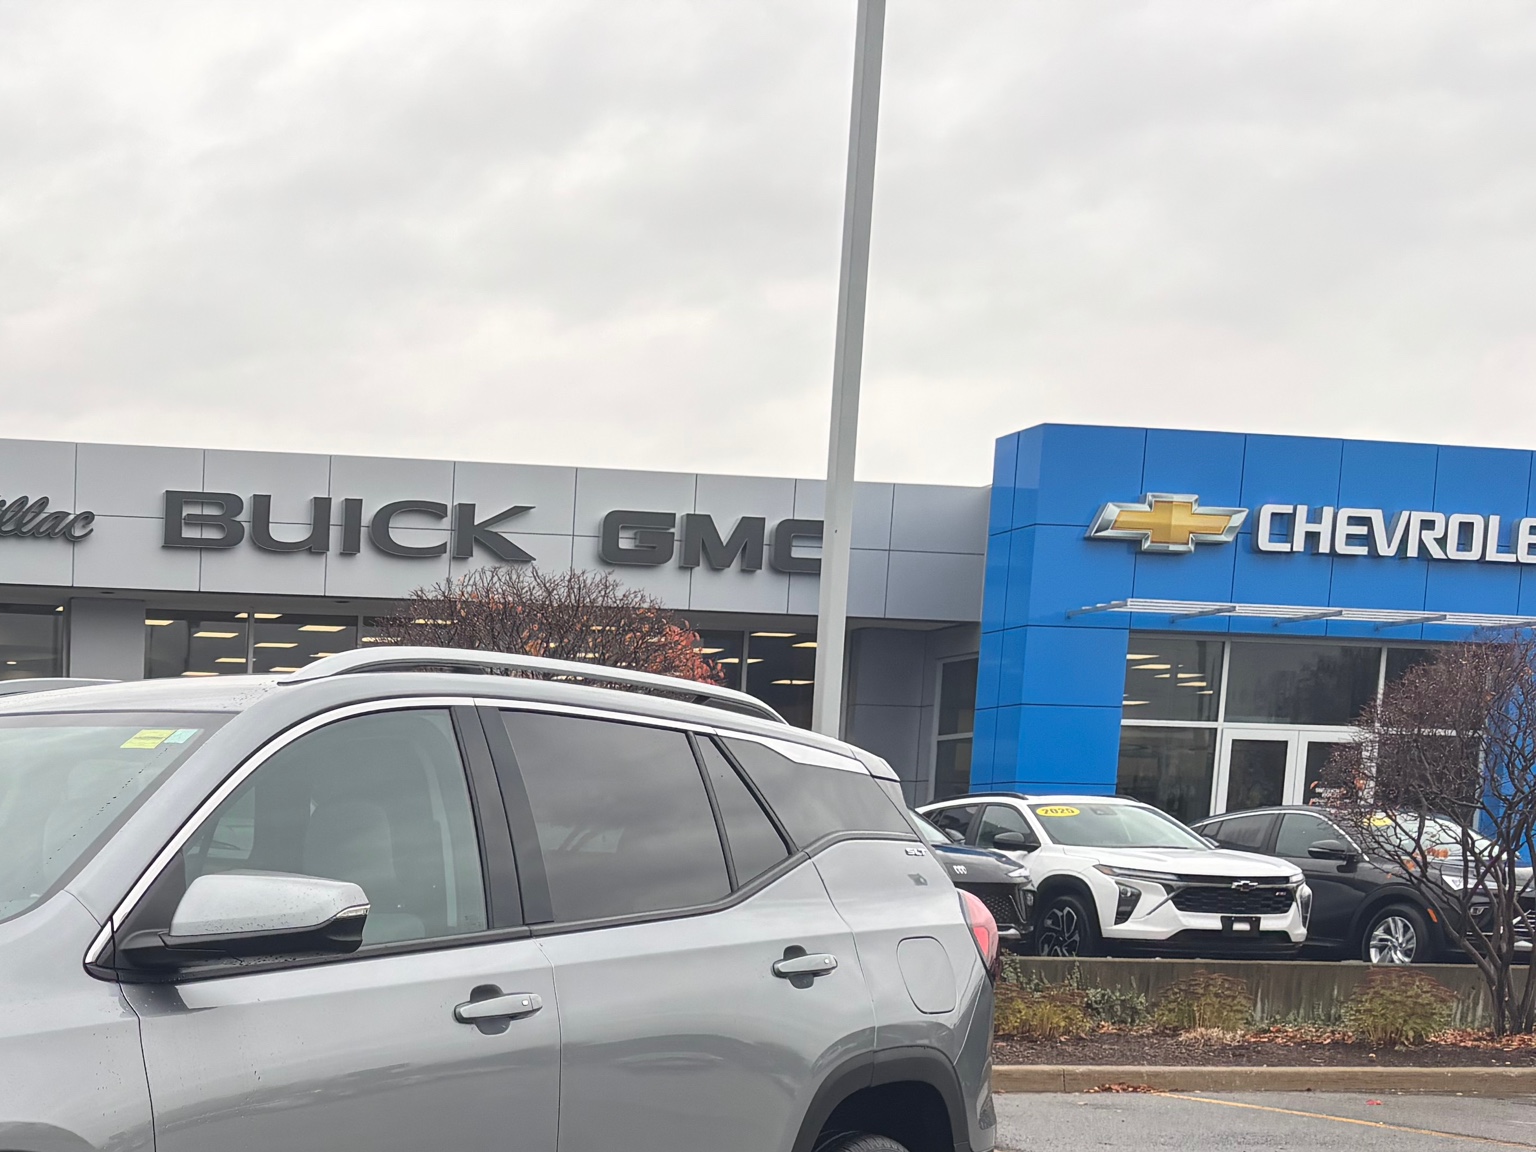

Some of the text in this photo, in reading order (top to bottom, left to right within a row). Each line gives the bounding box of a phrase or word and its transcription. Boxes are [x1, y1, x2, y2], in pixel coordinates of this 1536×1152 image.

[162, 490, 536, 561] BUICK
[600, 509, 824, 573] GMC
[1256, 503, 1536, 563] CHEVROLE
[905, 847, 926, 857] SLT
